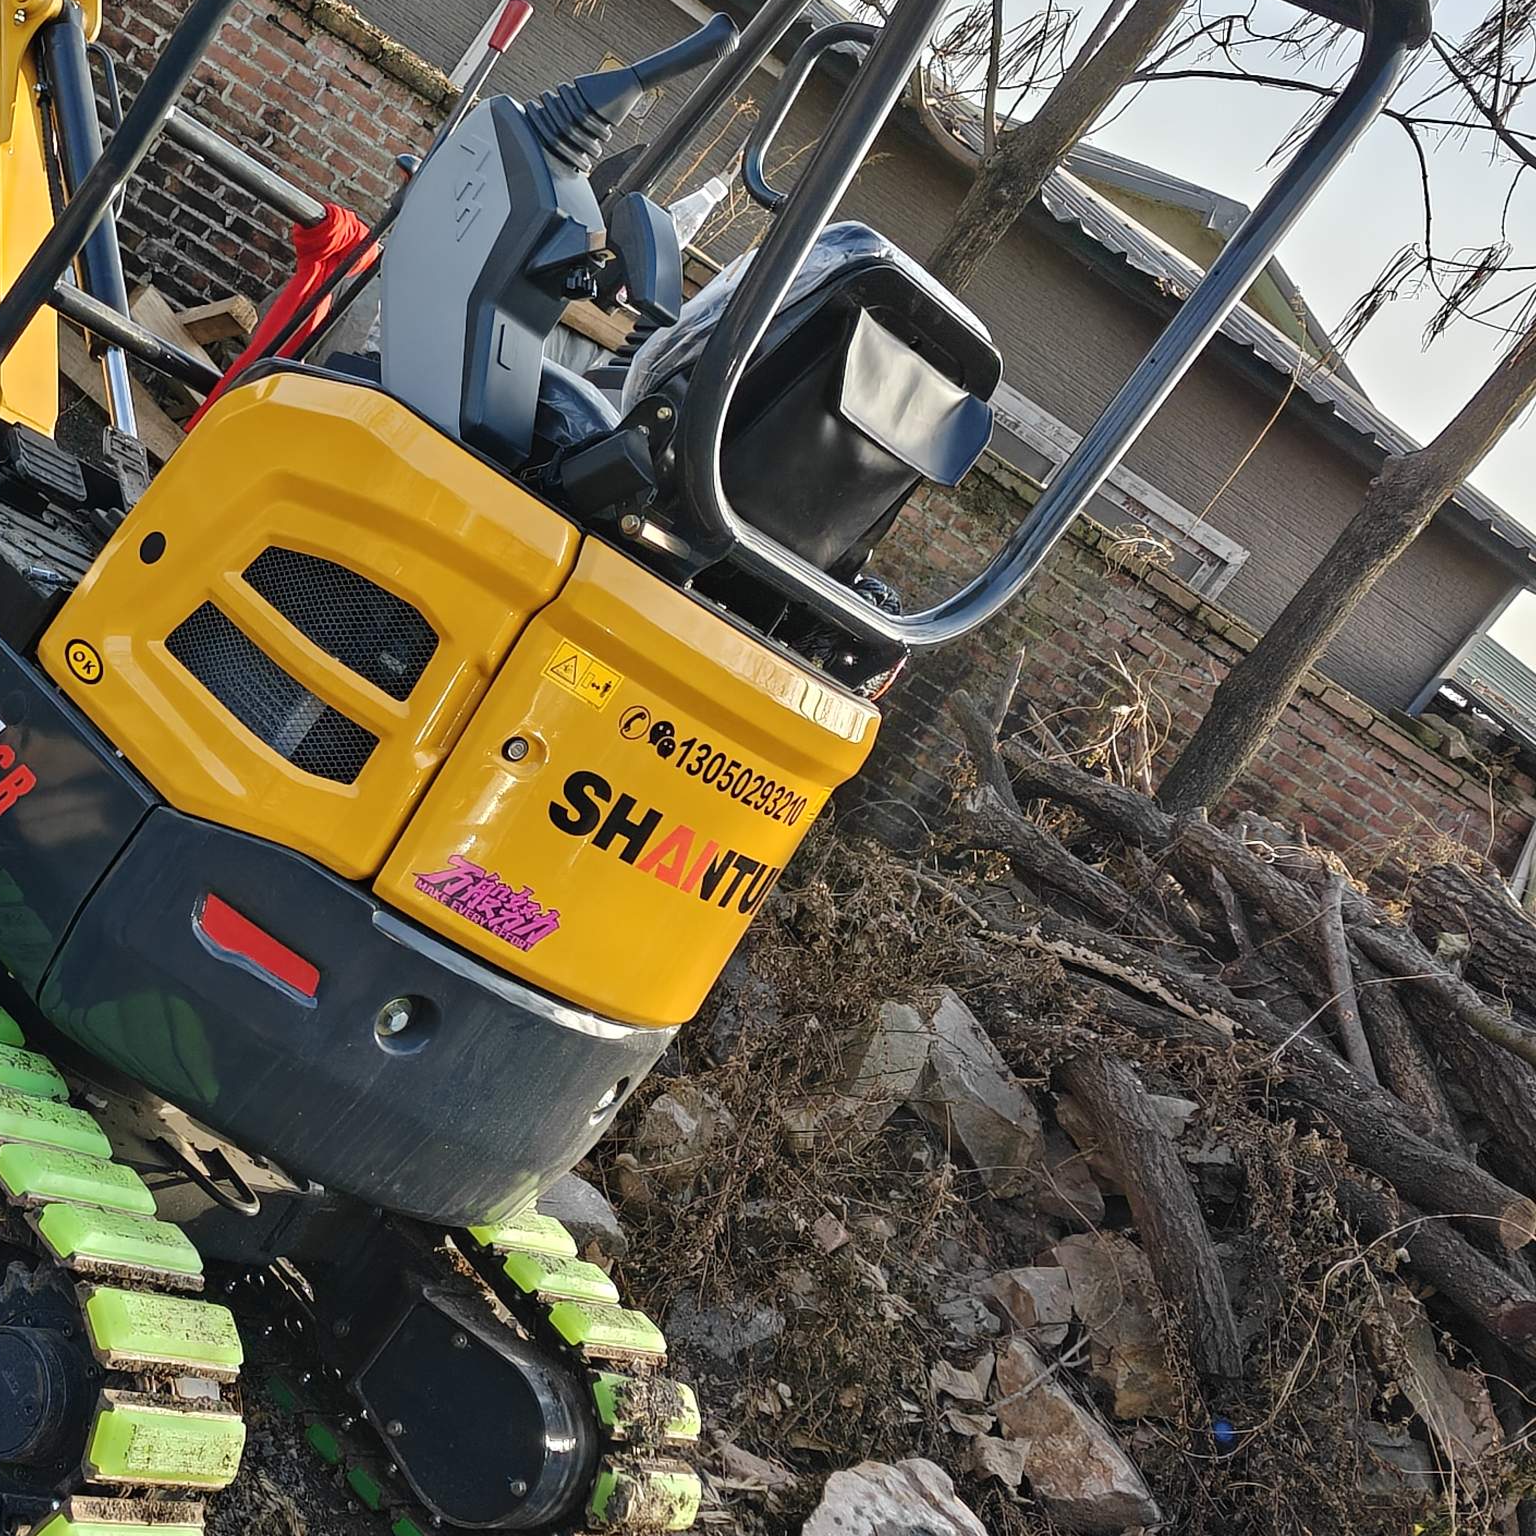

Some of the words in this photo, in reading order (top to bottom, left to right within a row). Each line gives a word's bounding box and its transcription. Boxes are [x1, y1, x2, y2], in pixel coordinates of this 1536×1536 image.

[73, 651, 96, 674] OK
[675, 737, 808, 827] 13050293210
[412, 854, 560, 944] 万般努力
[415, 879, 451, 905] MAKE
[450, 899, 489, 927] EVERY
